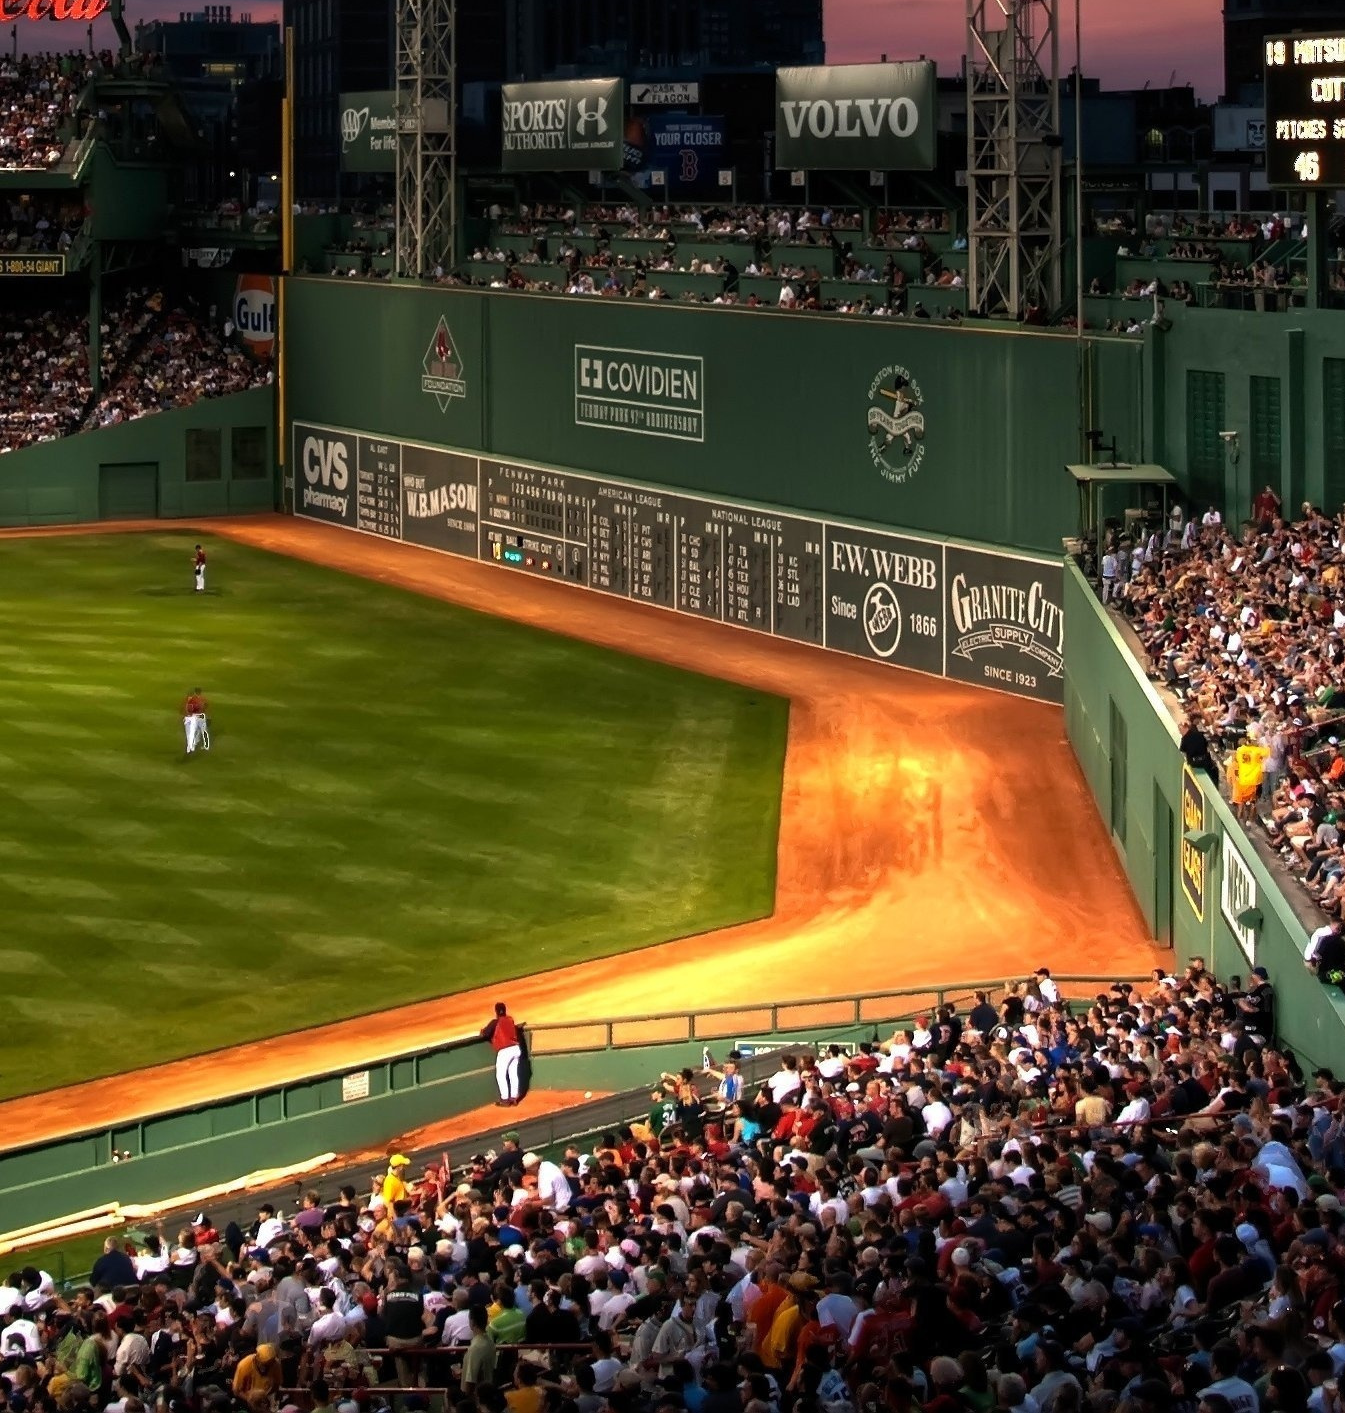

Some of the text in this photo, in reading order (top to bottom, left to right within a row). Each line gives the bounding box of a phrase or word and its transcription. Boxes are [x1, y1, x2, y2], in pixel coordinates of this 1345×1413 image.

[652, 94, 690, 103] FLAGON
[503, 99, 566, 131] SPORTS
[781, 98, 919, 138] VOLVO
[503, 131, 565, 150] AUTHORITY
[655, 132, 722, 146] YOUR CLOSER
[1275, 119, 1327, 140] PITCHES
[1294, 151, 1319, 181] 46
[35, 260, 59, 272] GIANT
[607, 362, 697, 400] COVIDIEN
[303, 436, 349, 490] CVS
[499, 467, 565, 489] FENWAY PARK
[304, 485, 348, 517] pharmacy
[598, 487, 662, 508] AMERICAN LEAGUE
[712, 509, 782, 532] NATIONAL LEAGUE
[737, 557, 748, 570] FLA
[871, 548, 937, 590] WEBB
[737, 570, 748, 583] TEX
[787, 569, 799, 581] STL
[787, 582, 799, 594] LAA
[787, 595, 800, 607] LAD
[831, 595, 857, 620] Since
[910, 613, 937, 637] 1866
[994, 628, 1030, 644] SUPPLY
[1031, 644, 1061, 668] COMPANY
[984, 665, 1037, 688] SINCE 1923
